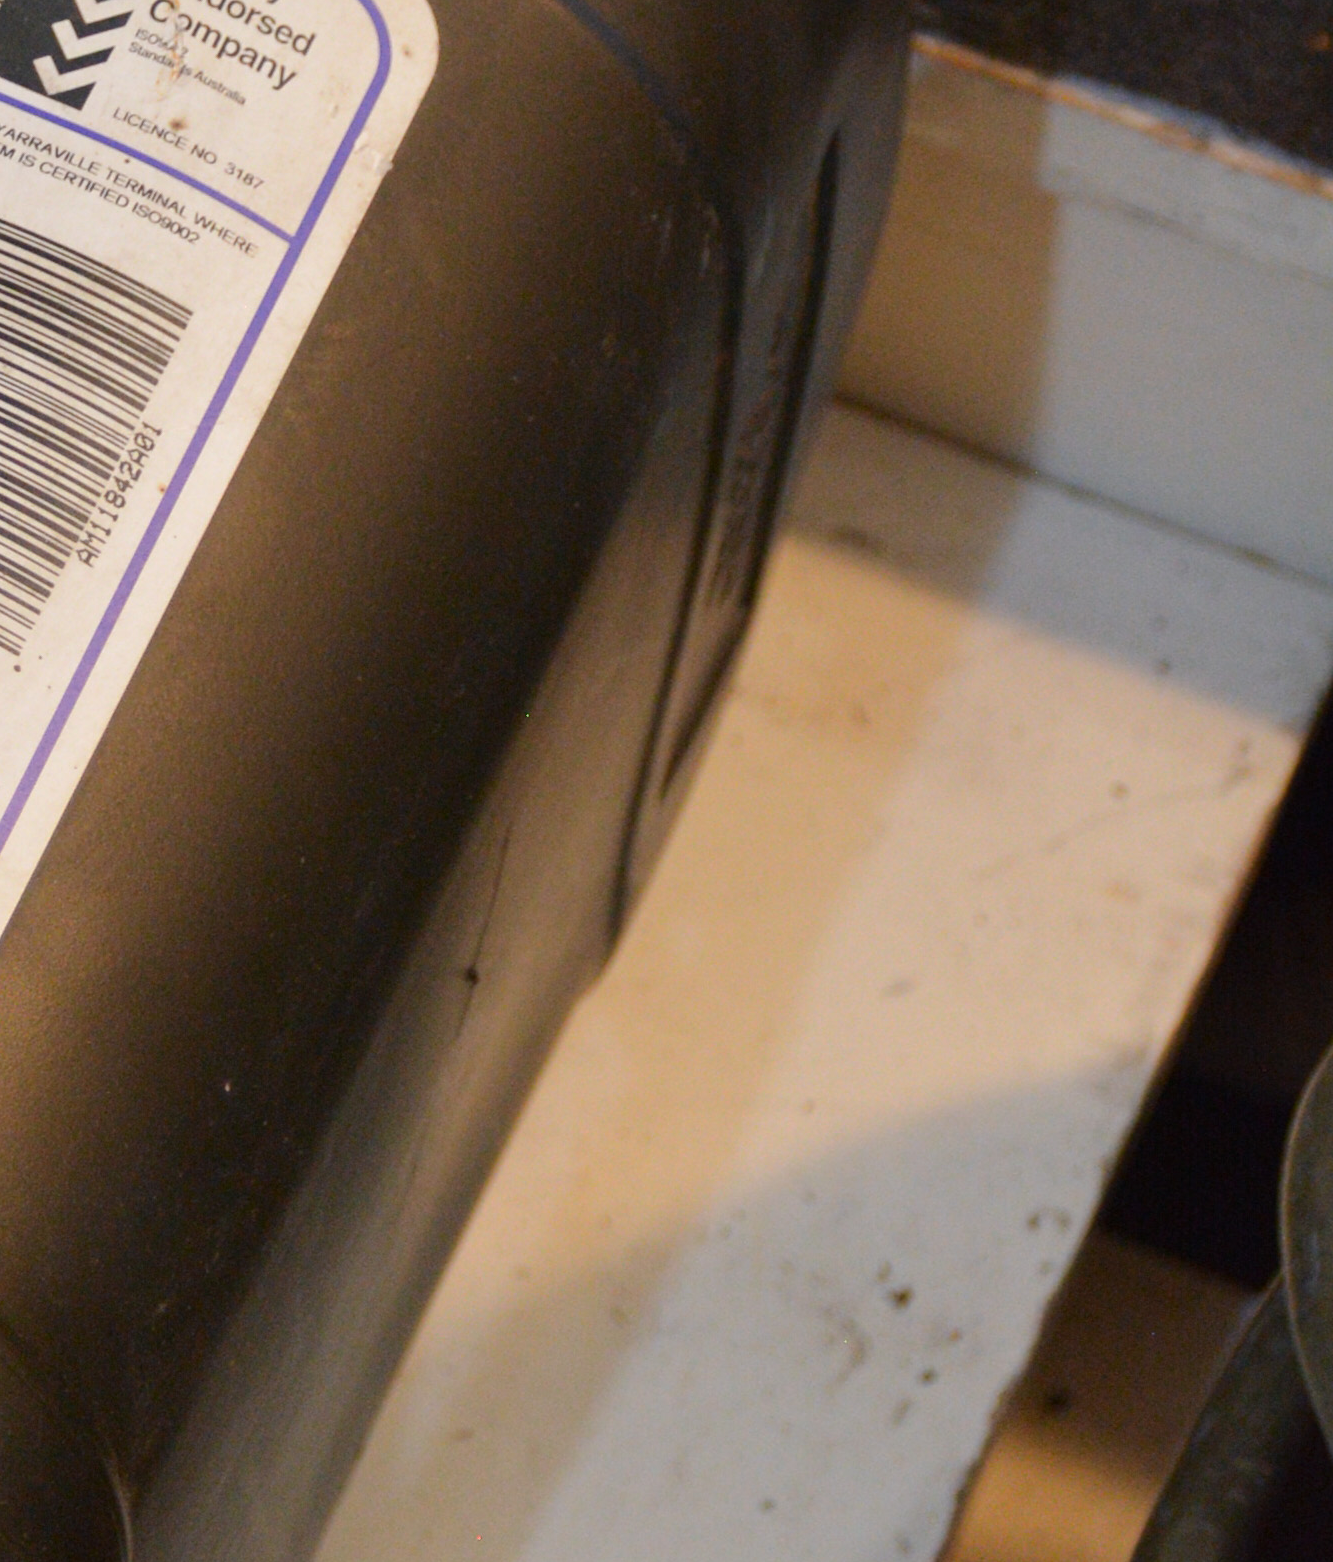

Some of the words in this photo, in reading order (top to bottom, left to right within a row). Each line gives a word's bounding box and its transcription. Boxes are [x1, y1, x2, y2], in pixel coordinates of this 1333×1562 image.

[194, 70, 247, 106] Australia
[112, 106, 188, 152] LICENCE
[190, 142, 218, 167] NO
[223, 161, 265, 192] 3187
[17, 151, 36, 168] IS
[39, 160, 130, 210] CERTIFIED
[131, 200, 202, 246] ISO9002
[105, 166, 188, 220] TERMINAL
[193, 212, 259, 260] WHERE
